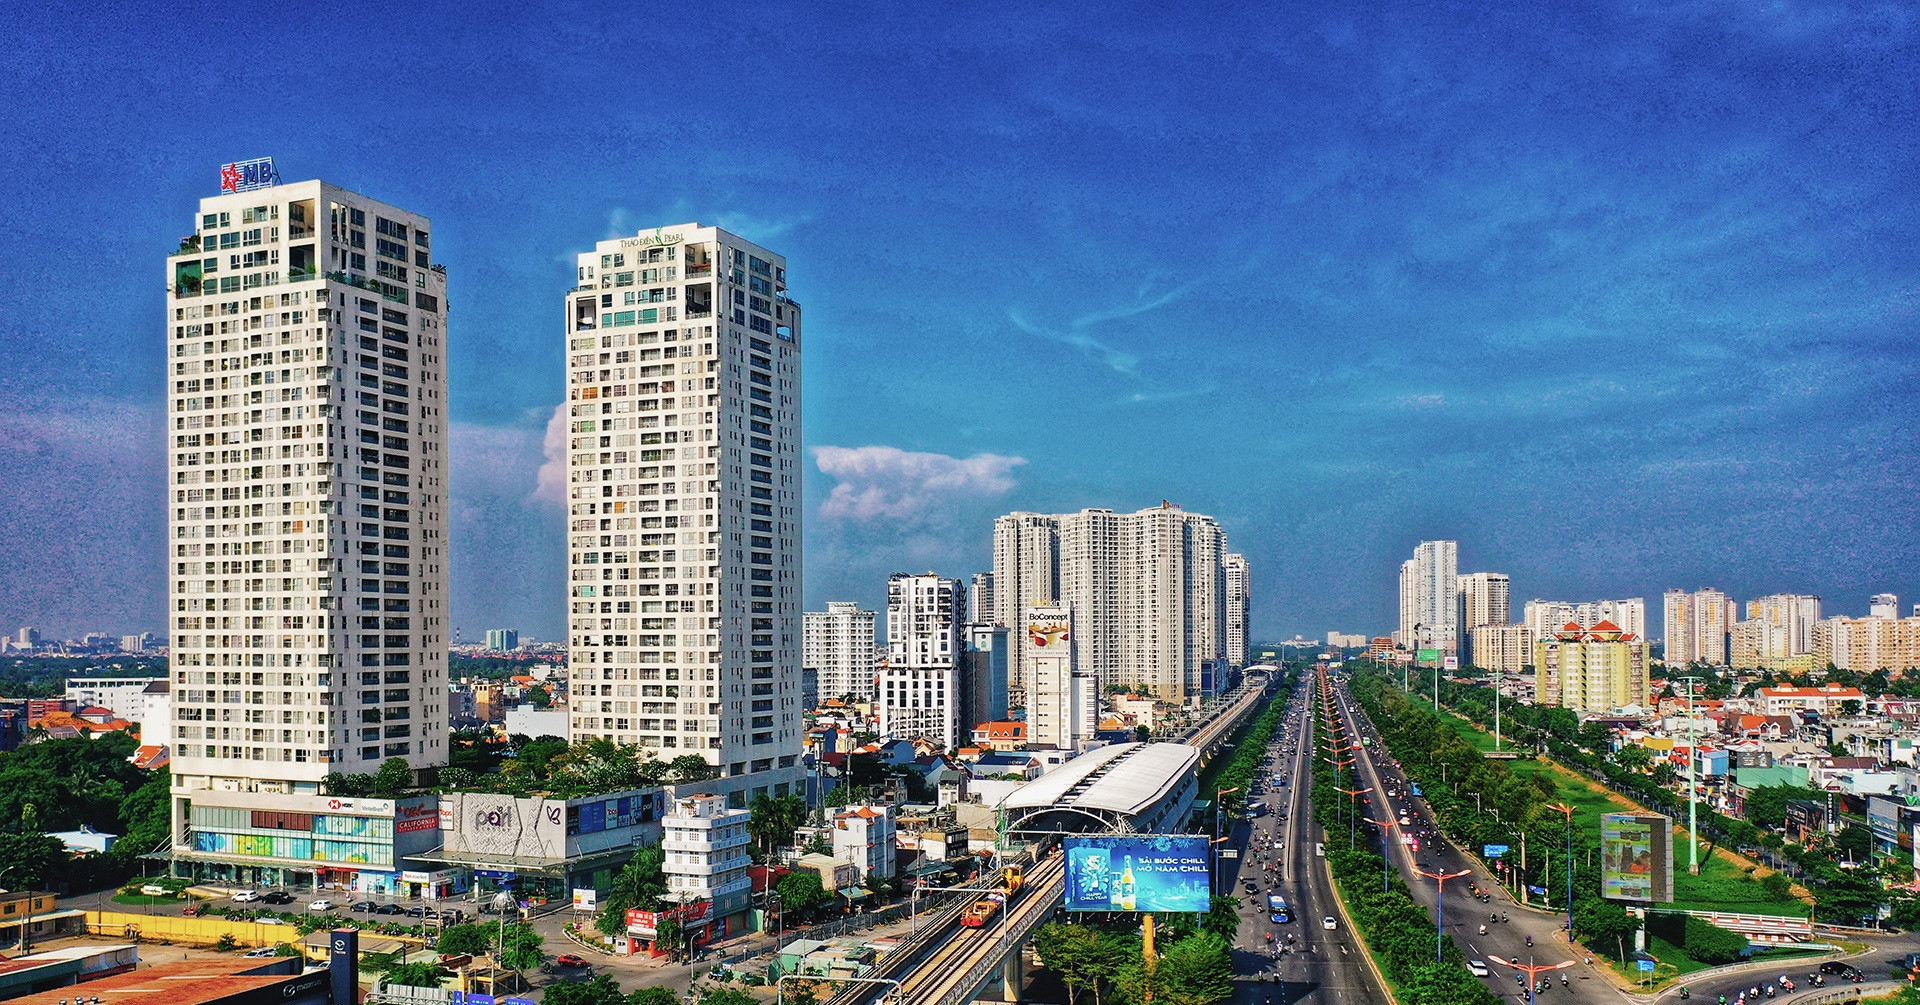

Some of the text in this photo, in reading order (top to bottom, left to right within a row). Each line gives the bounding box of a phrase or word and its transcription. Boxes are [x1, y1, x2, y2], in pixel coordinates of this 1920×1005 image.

[244, 162, 273, 185] MB
[665, 233, 685, 242] PEARL
[1029, 613, 1068, 621] BoConcept
[400, 818, 435, 829] CALIFORNIA
